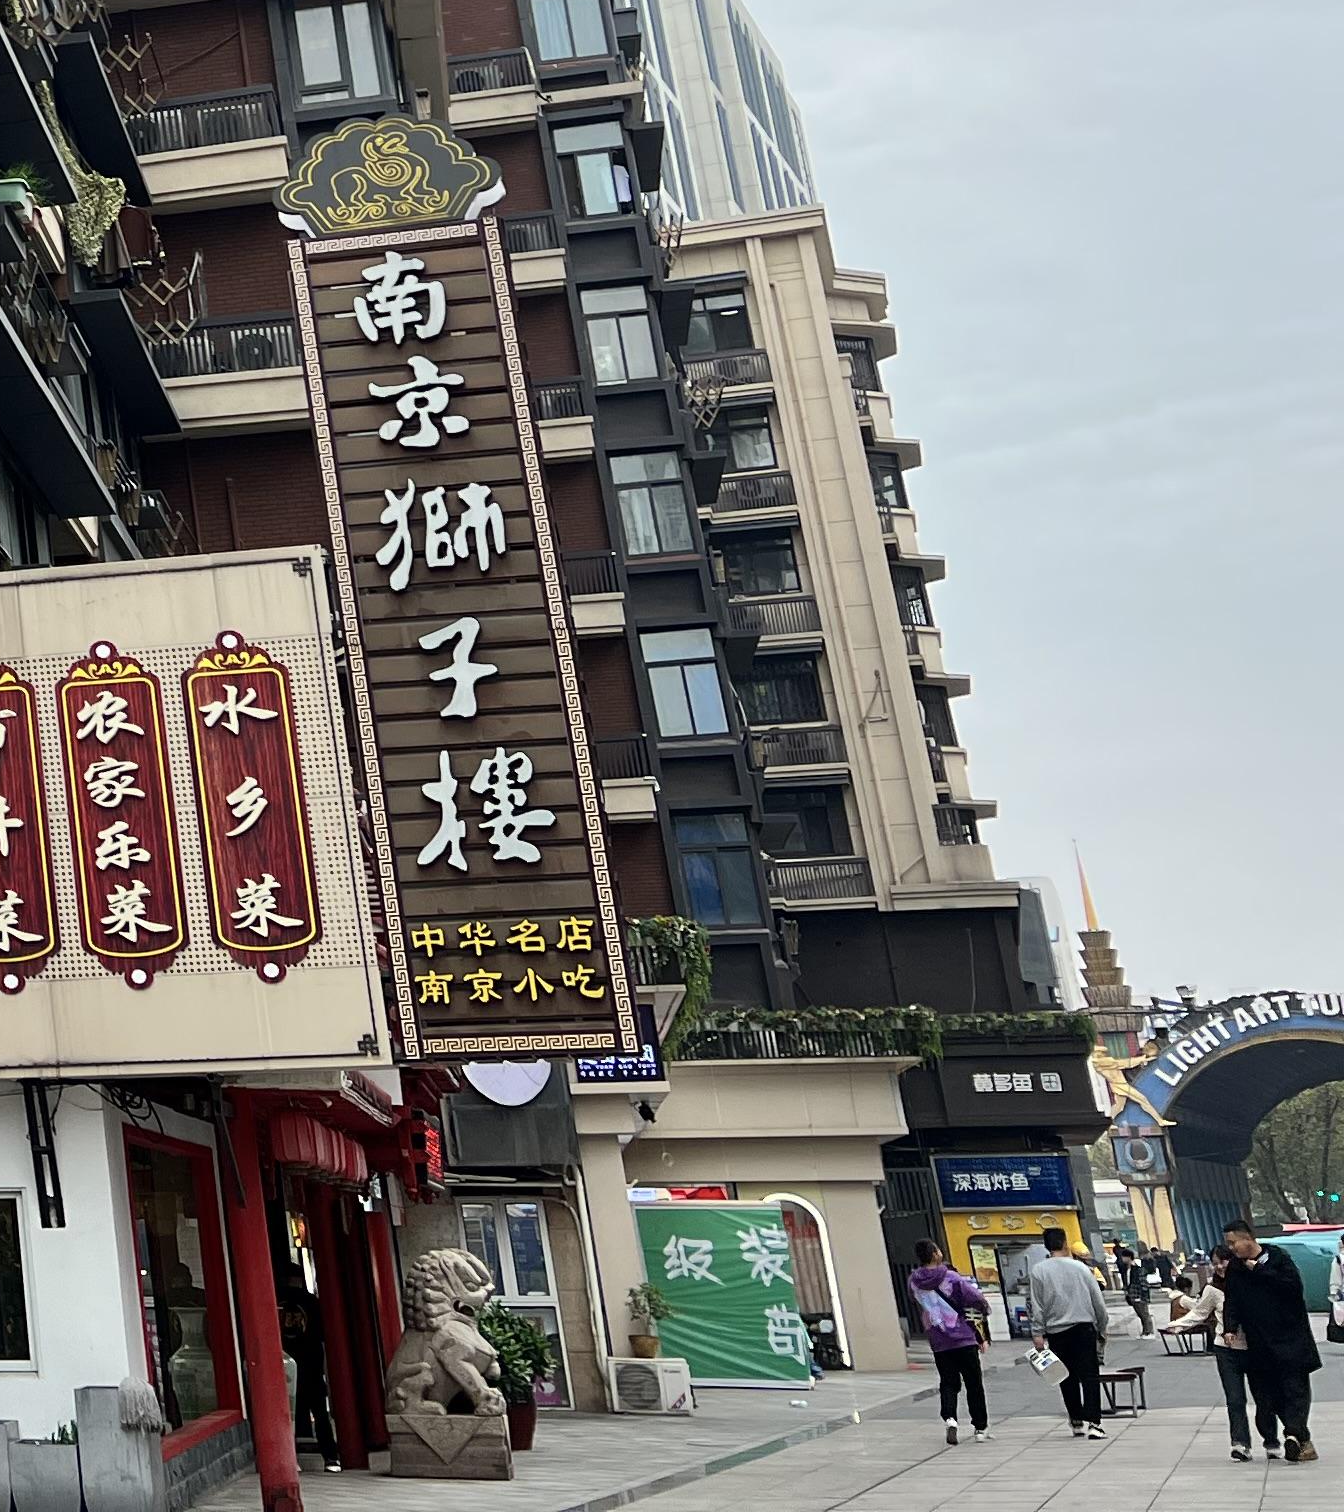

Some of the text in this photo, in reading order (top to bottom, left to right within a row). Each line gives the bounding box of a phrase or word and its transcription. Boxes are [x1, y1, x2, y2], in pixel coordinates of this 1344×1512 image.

[75, 689, 173, 943] 农家乐菜
[197, 683, 305, 937] 水乡菜
[411, 915, 594, 958] 中华名店
[414, 963, 606, 1005] 南京小吃
[1154, 1011, 1232, 1088] LIGHT
[1232, 995, 1292, 1034] ART
[952, 1172, 1031, 1192] 深海炸鱼
